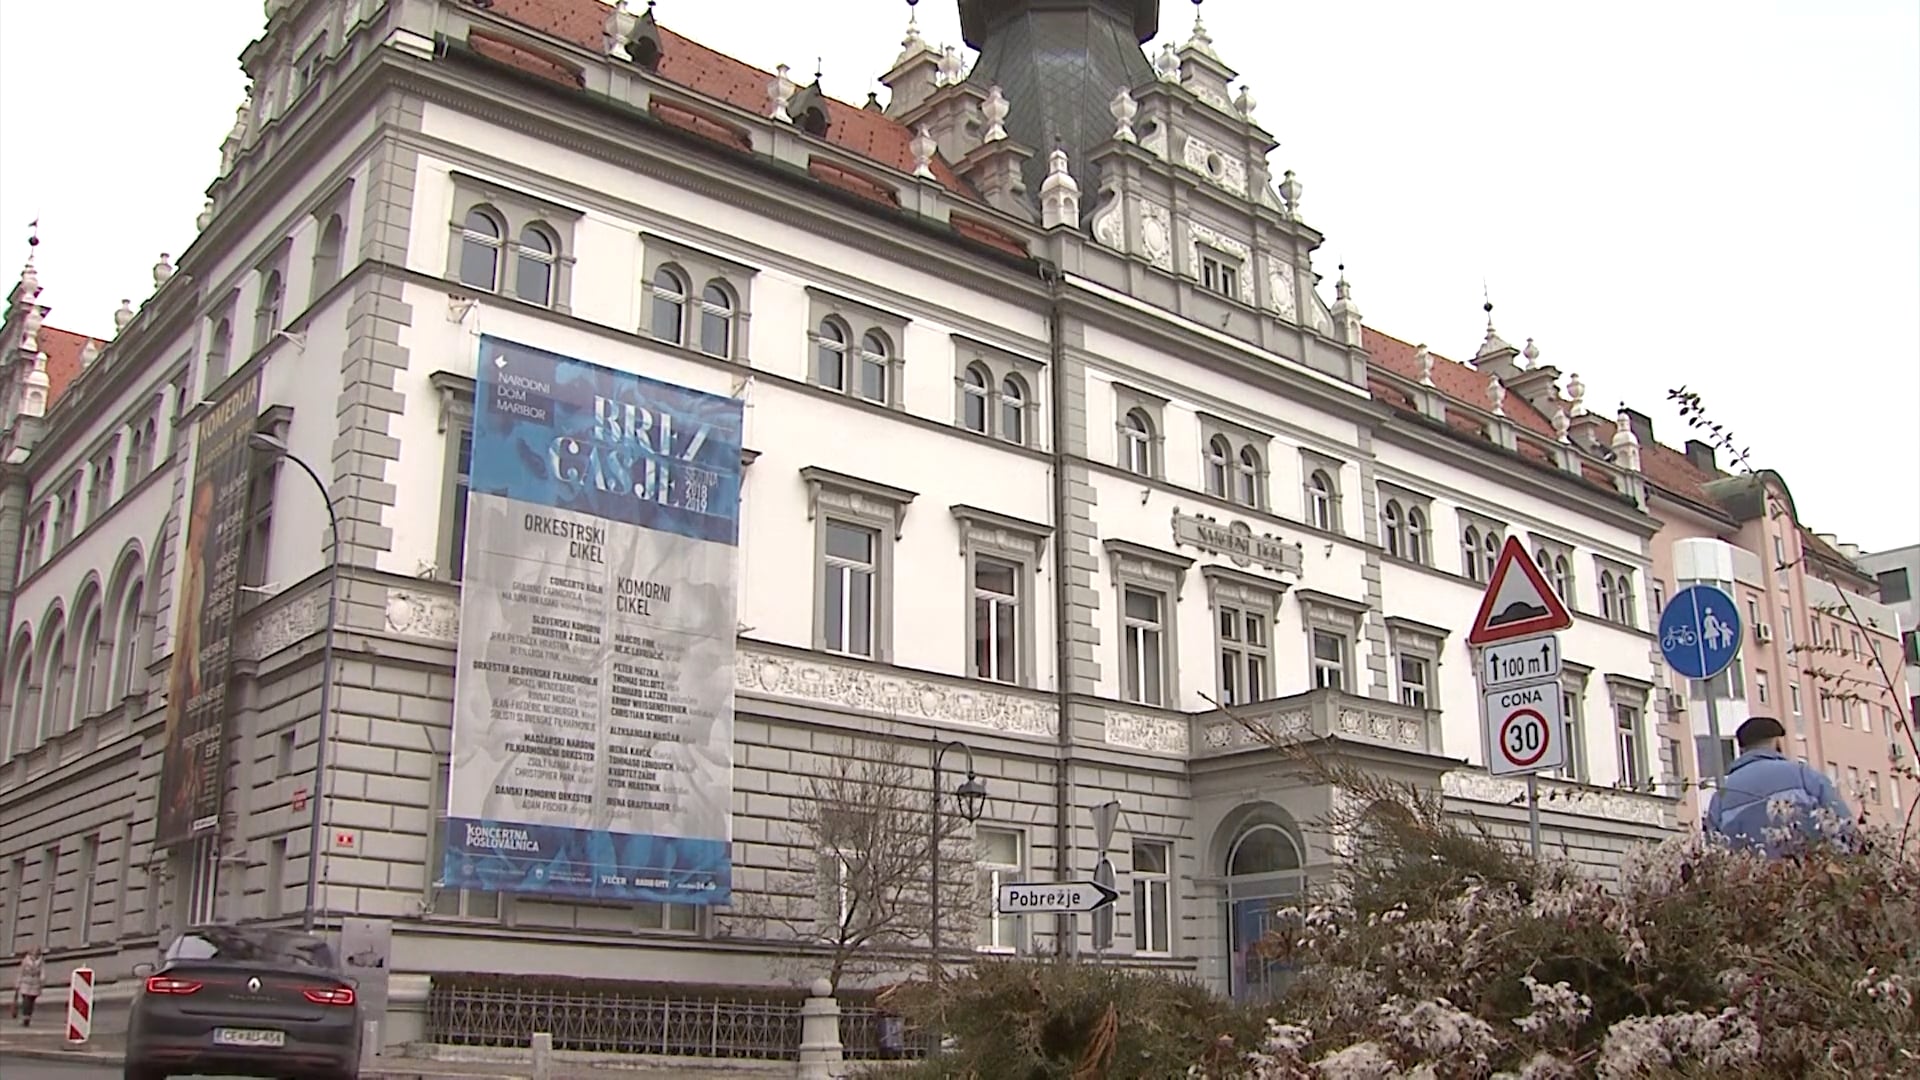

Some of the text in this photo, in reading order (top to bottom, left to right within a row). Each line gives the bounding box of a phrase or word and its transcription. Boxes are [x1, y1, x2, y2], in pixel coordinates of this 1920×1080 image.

[497, 385, 526, 401] DOM
[498, 372, 551, 395] NARODNI
[497, 399, 546, 420] MARIBOR
[685, 480, 707, 499] 2018
[685, 496, 707, 513] 2019
[525, 513, 605, 545] ORKESTRSKI
[569, 541, 604, 564] CIKEL
[618, 576, 671, 602] KOMORNI
[616, 595, 651, 617] CIKEL
[533, 615, 570, 629] SLOVENSKI
[531, 626, 567, 640] ORKESTER
[473, 660, 510, 673] ORKESTER
[512, 665, 551, 679] SLOVENSKE
[613, 662, 633, 674] PETER
[1502, 656, 1540, 679] 100 m
[613, 673, 638, 686] THOMAS
[1501, 690, 1543, 709] CONA
[611, 706, 645, 720] CHRISTIAN
[524, 733, 565, 746] MADŽARSKI
[1510, 721, 1539, 753] 30
[561, 748, 595, 761] ORKESTER
[514, 767, 558, 780] CHRISTOPHER
[495, 785, 592, 804] DANSKI KOMORNI ORKESTER
[465, 822, 528, 840] KONCERTNA
[466, 834, 540, 852] POSLOVALNICA
[1009, 889, 1081, 908] Pobrežje
